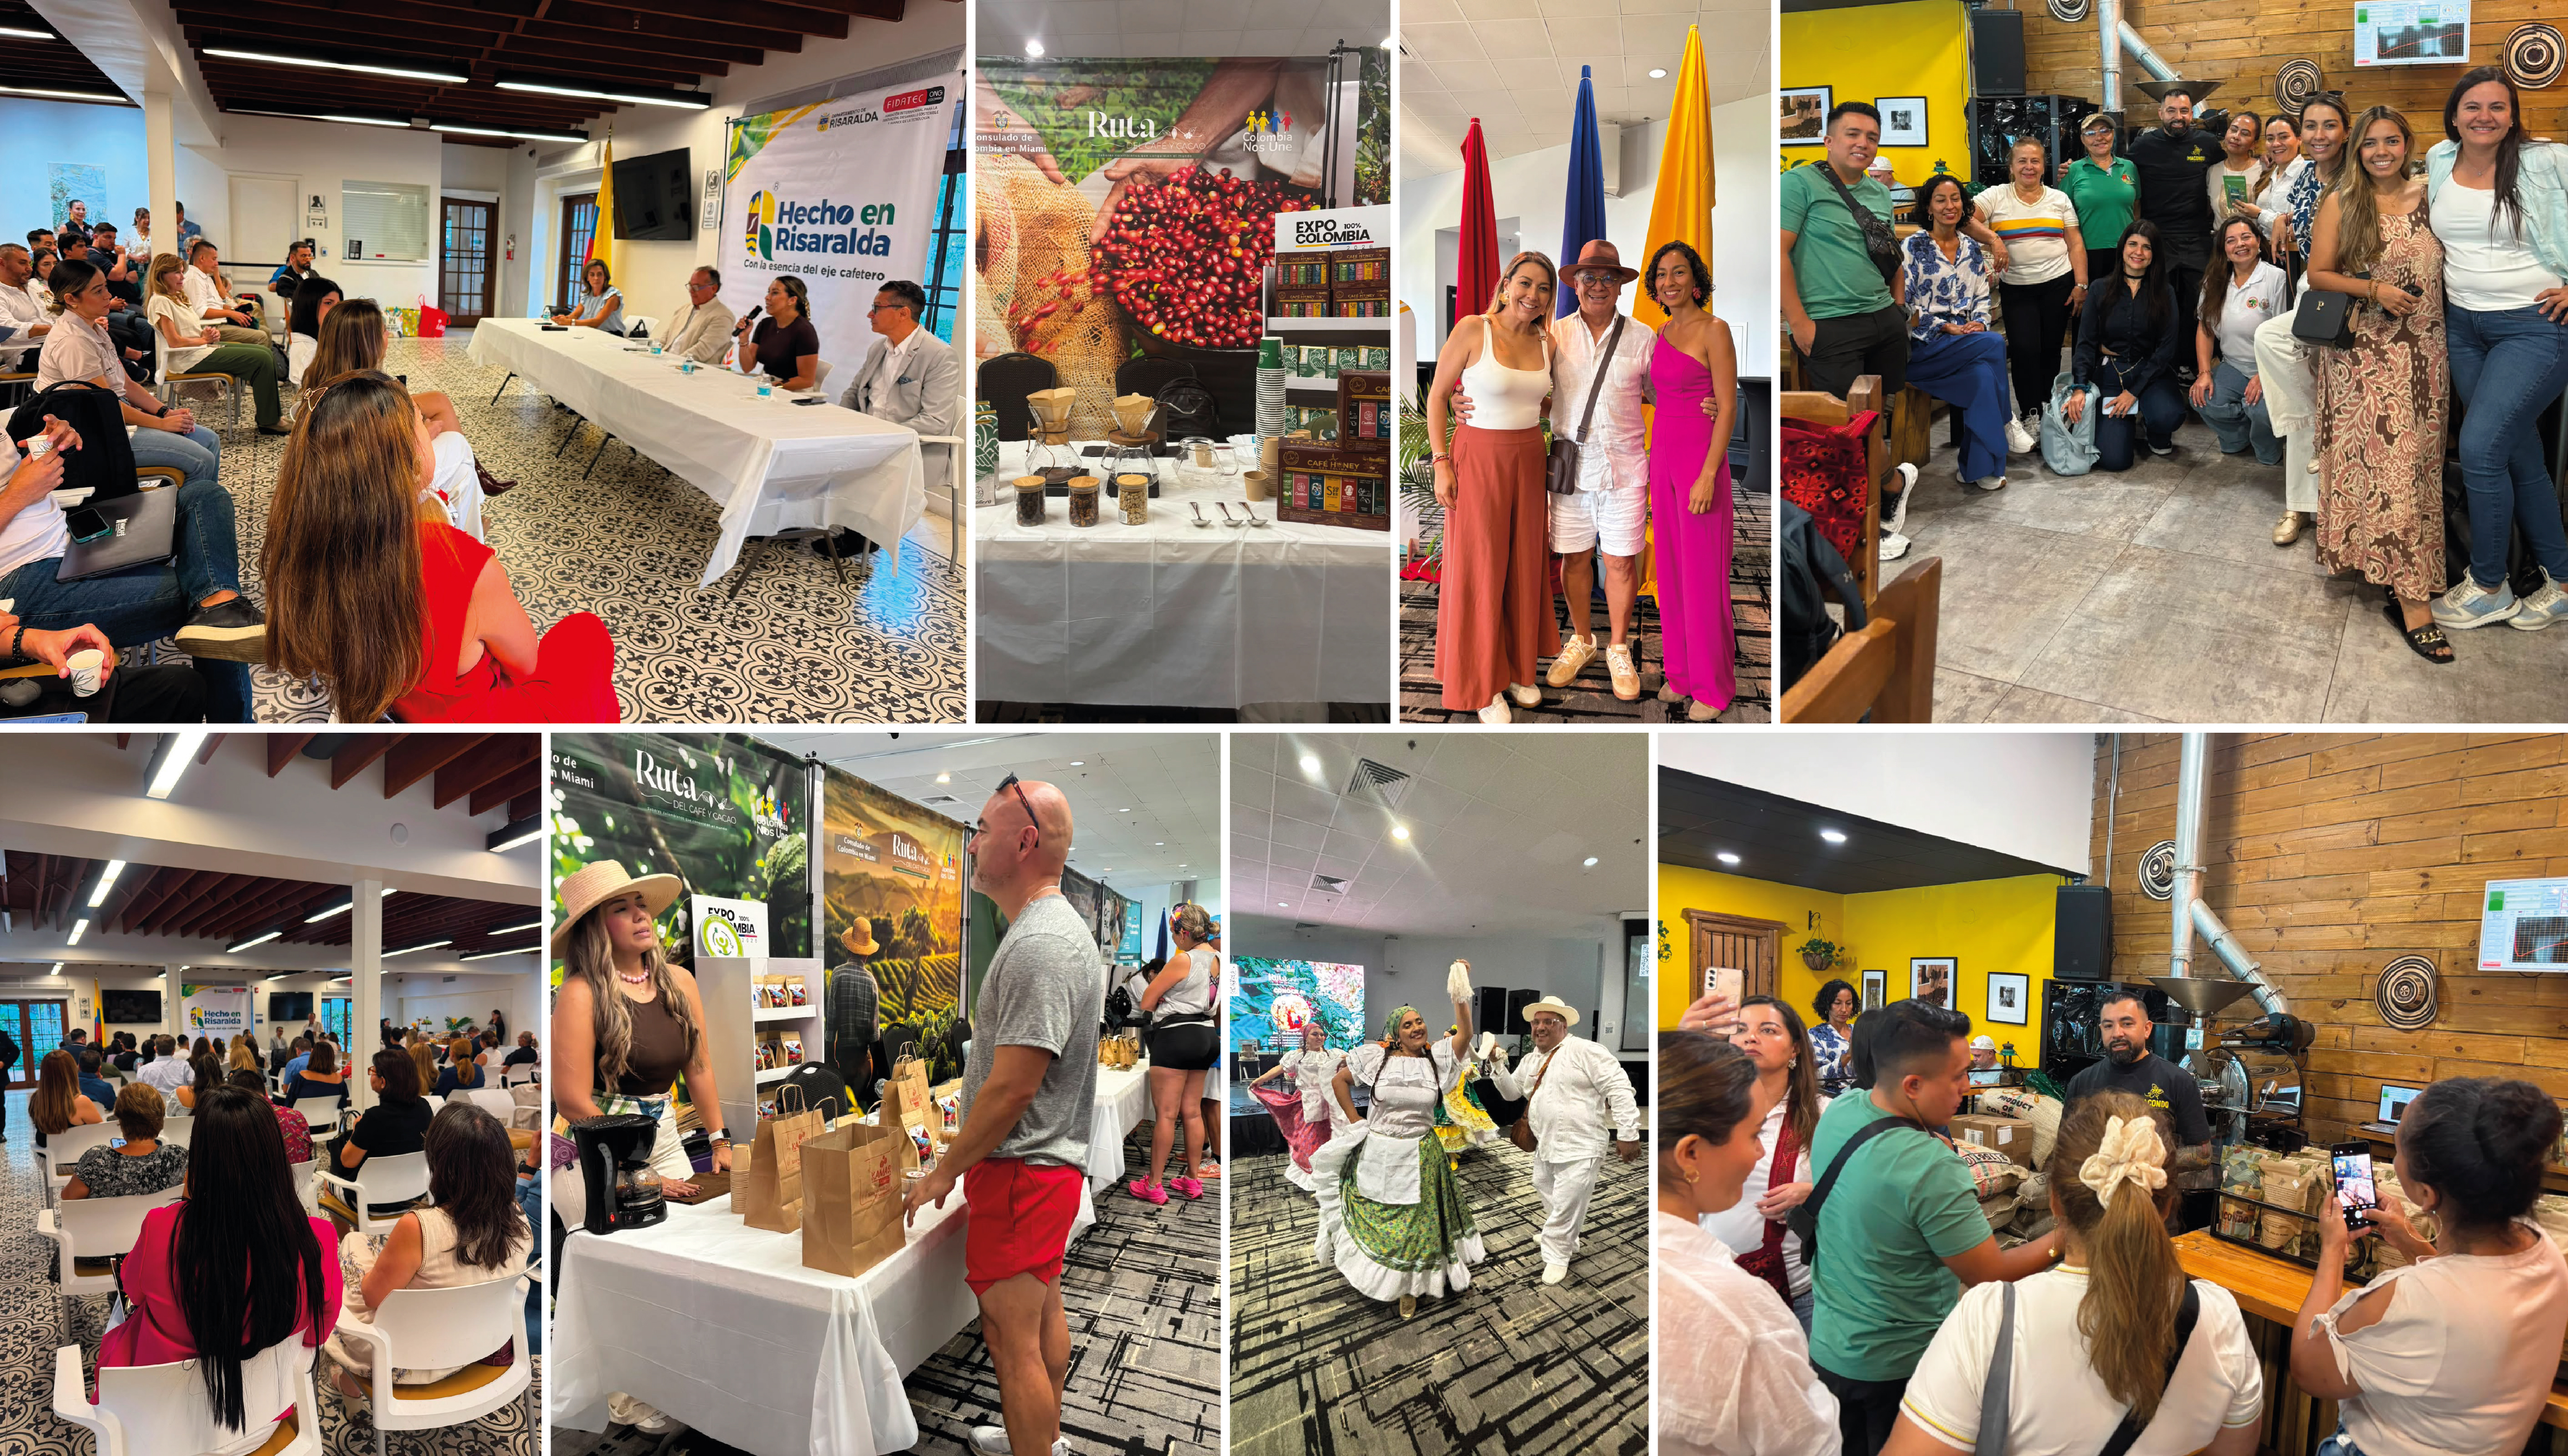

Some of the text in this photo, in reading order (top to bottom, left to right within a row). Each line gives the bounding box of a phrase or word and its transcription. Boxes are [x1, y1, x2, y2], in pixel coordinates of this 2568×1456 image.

[887, 94, 924, 109] FIDATEC
[829, 111, 878, 129] RISARALDA
[1087, 111, 1156, 138] Ruta
[1021, 133, 1033, 141] de
[1243, 132, 1293, 142] Colombia
[1019, 144, 1047, 153] Miami
[1176, 142, 1206, 150] CACAO
[1243, 142, 1293, 152] Nos Une
[778, 199, 895, 225] Hecho en
[1296, 219, 1336, 234] EXPO
[776, 226, 891, 257] Risaralda
[1295, 229, 1370, 244] COLOMBIA
[744, 259, 885, 281] Con la esencia del eje cafetero
[551, 750, 576, 769] o de
[561, 769, 594, 789] Miami
[635, 748, 698, 801] Ruta
[673, 800, 737, 825] DEL CAFÉ Y CACAO
[757, 815, 788, 831] Colombia
[757, 824, 788, 841] Nos Une
[844, 836, 864, 850] Consulado
[893, 834, 918, 862] Ruta
[838, 844, 859, 856] Colombia
[864, 853, 877, 862] Miami
[942, 865, 955, 874] lombia
[1997, 1095, 2034, 1112] PRODUCT
[2002, 1104, 2013, 1113] OF
[2144, 1099, 2169, 1108] CONDO
